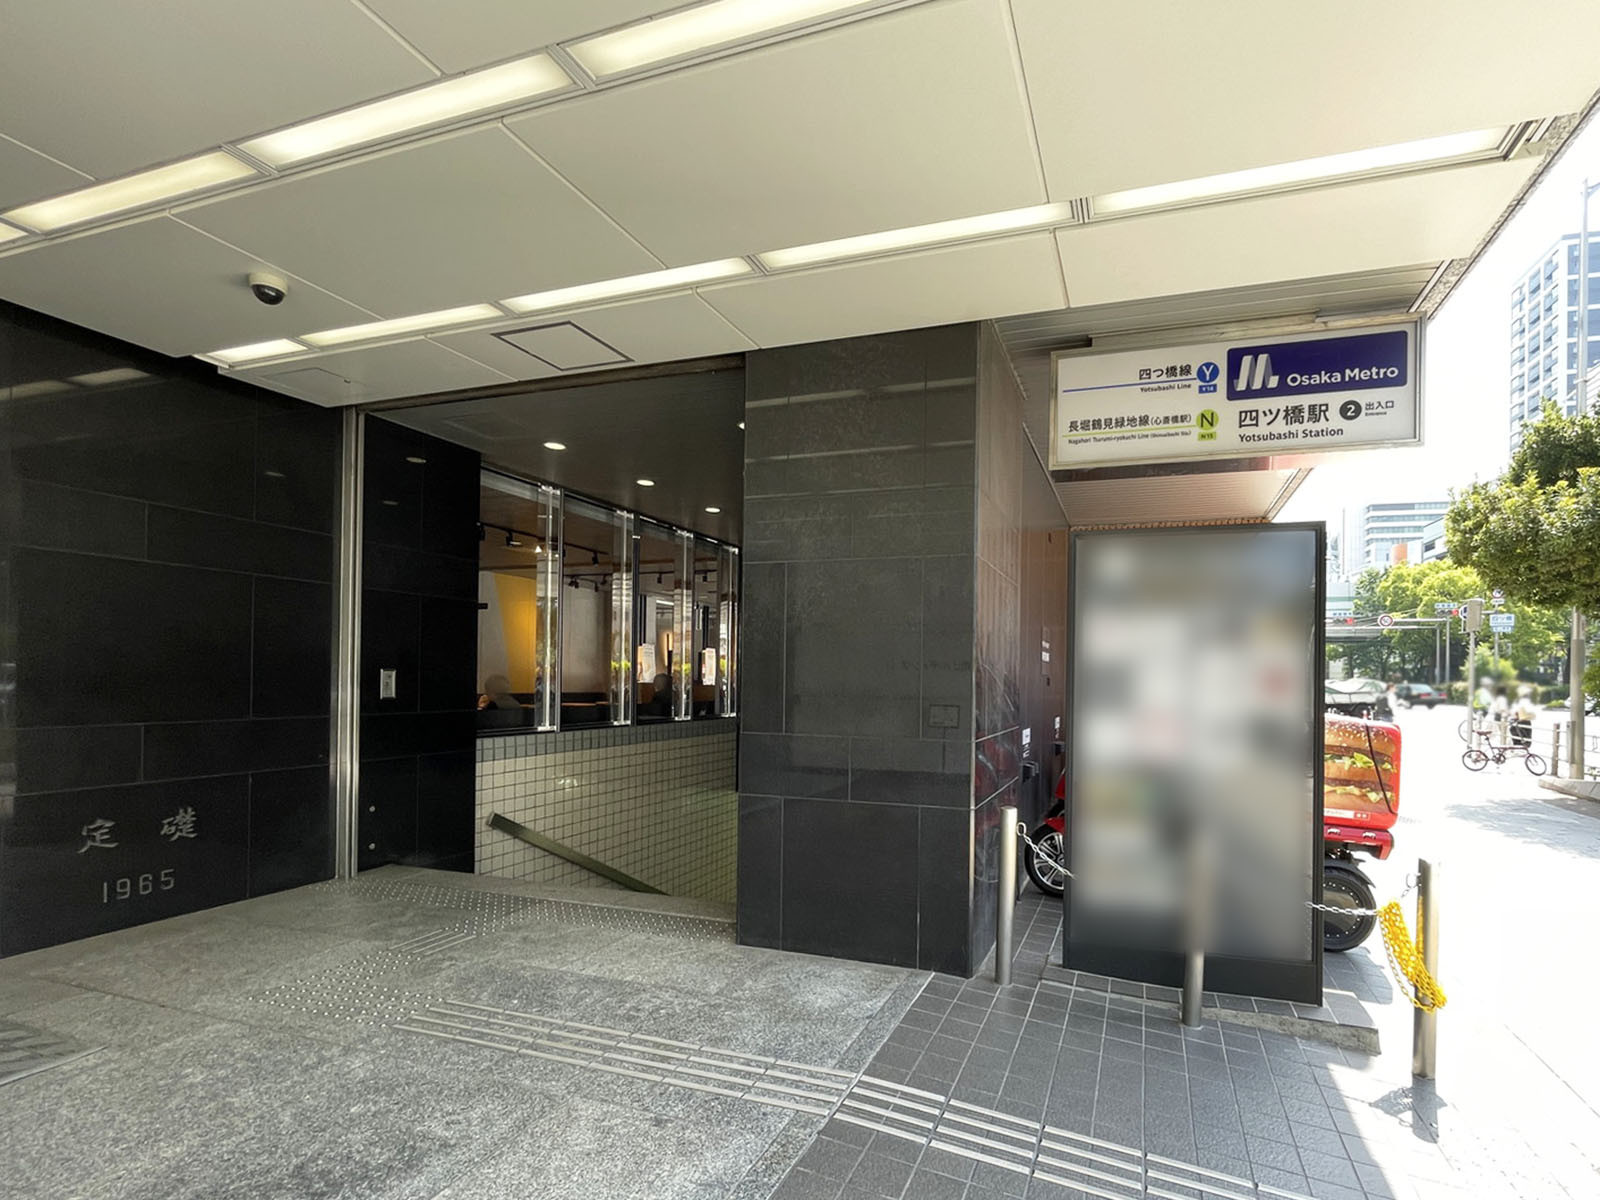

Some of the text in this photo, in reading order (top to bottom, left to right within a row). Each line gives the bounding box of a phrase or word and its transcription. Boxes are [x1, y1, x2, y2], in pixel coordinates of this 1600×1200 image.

[1139, 364, 1192, 380] 四つ橋線
[1287, 366, 1399, 386] Osaka Metro
[1140, 384, 1176, 392] Yotsubashi
[1365, 400, 1394, 410] 出入口
[1200, 412, 1214, 428] N
[1238, 403, 1330, 428] 四ツ橋駅
[1239, 427, 1343, 442] Yotsubashi Station
[77, 806, 198, 854] 定礎
[103, 868, 175, 903] 1965
